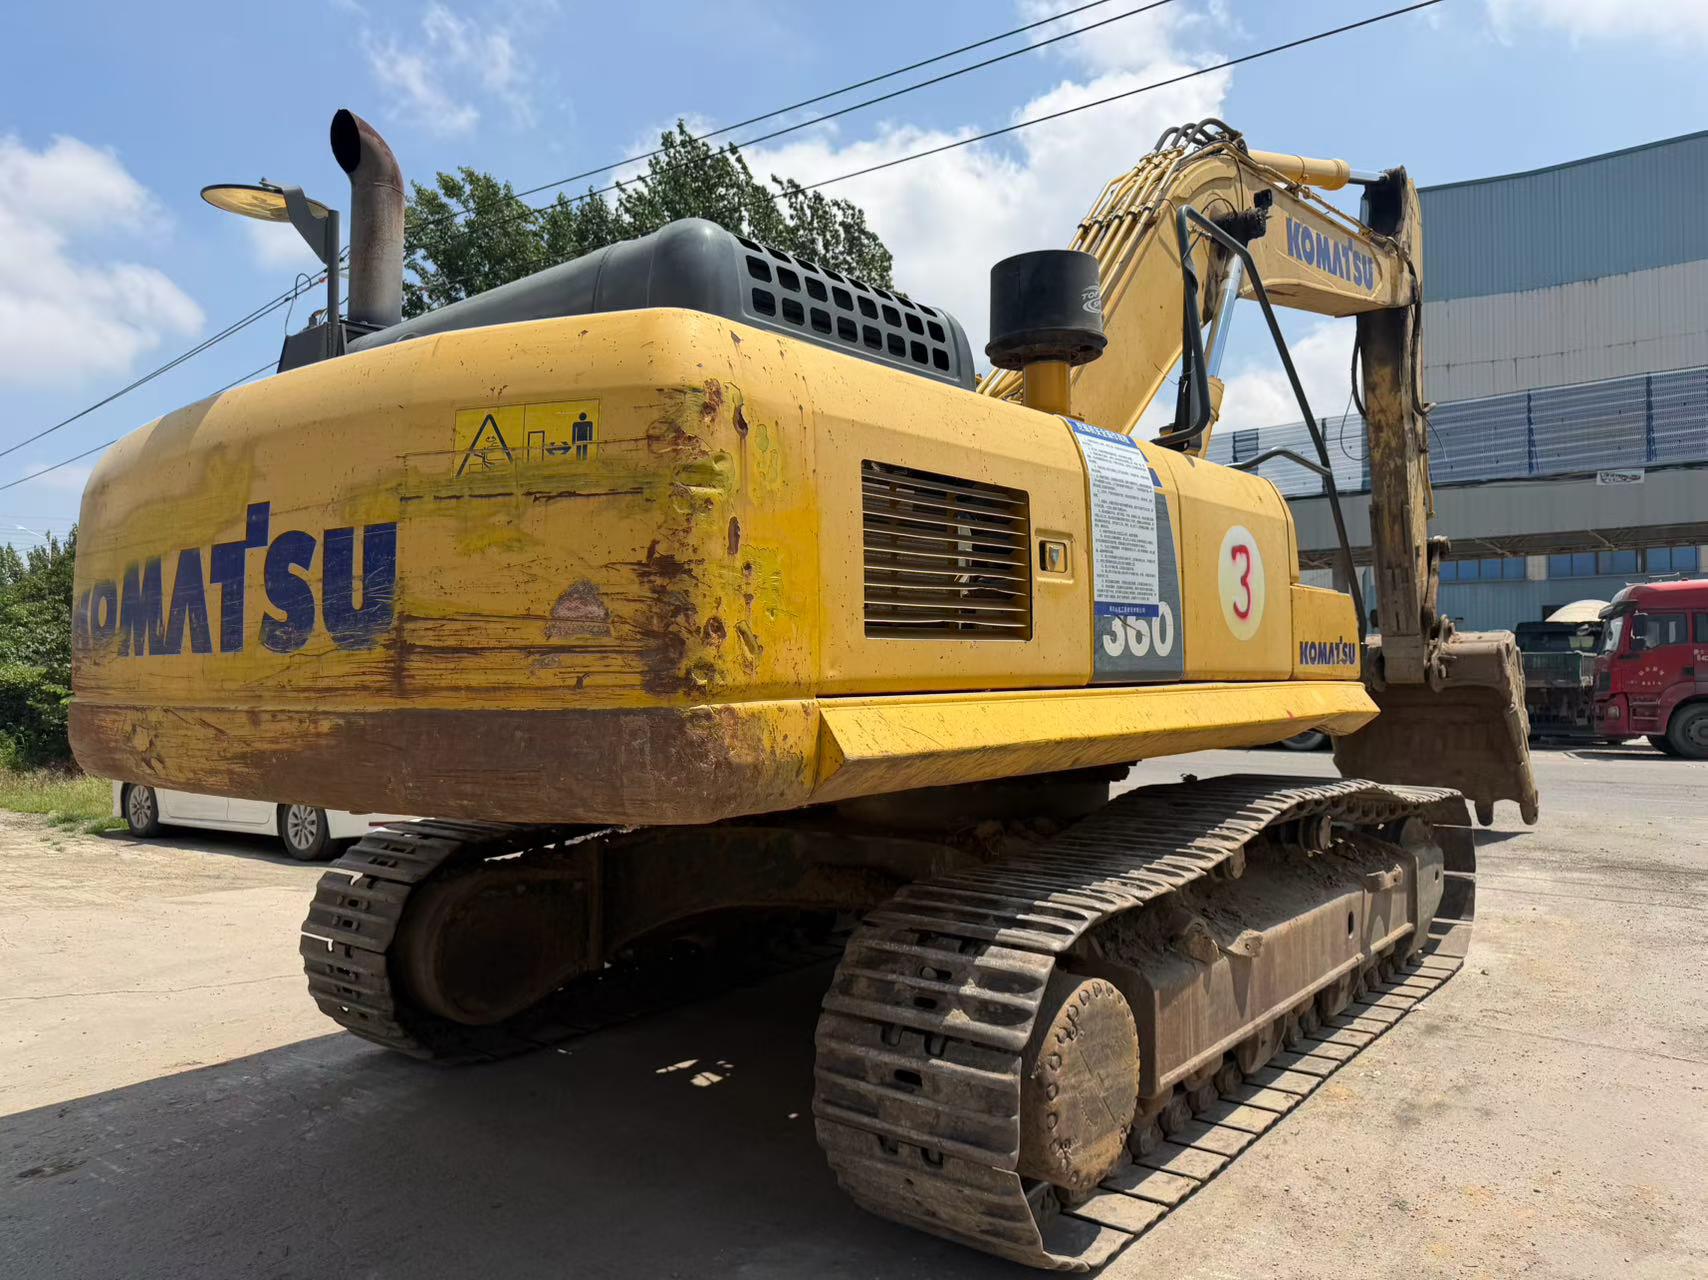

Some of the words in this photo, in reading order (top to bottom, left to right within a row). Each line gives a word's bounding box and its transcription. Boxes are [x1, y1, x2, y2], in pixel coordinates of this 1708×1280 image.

[1286, 216, 1374, 291] KOMATSU
[1231, 544, 1251, 620] 3
[1103, 601, 1174, 657] 360
[1299, 635, 1356, 665] KOMATSU
